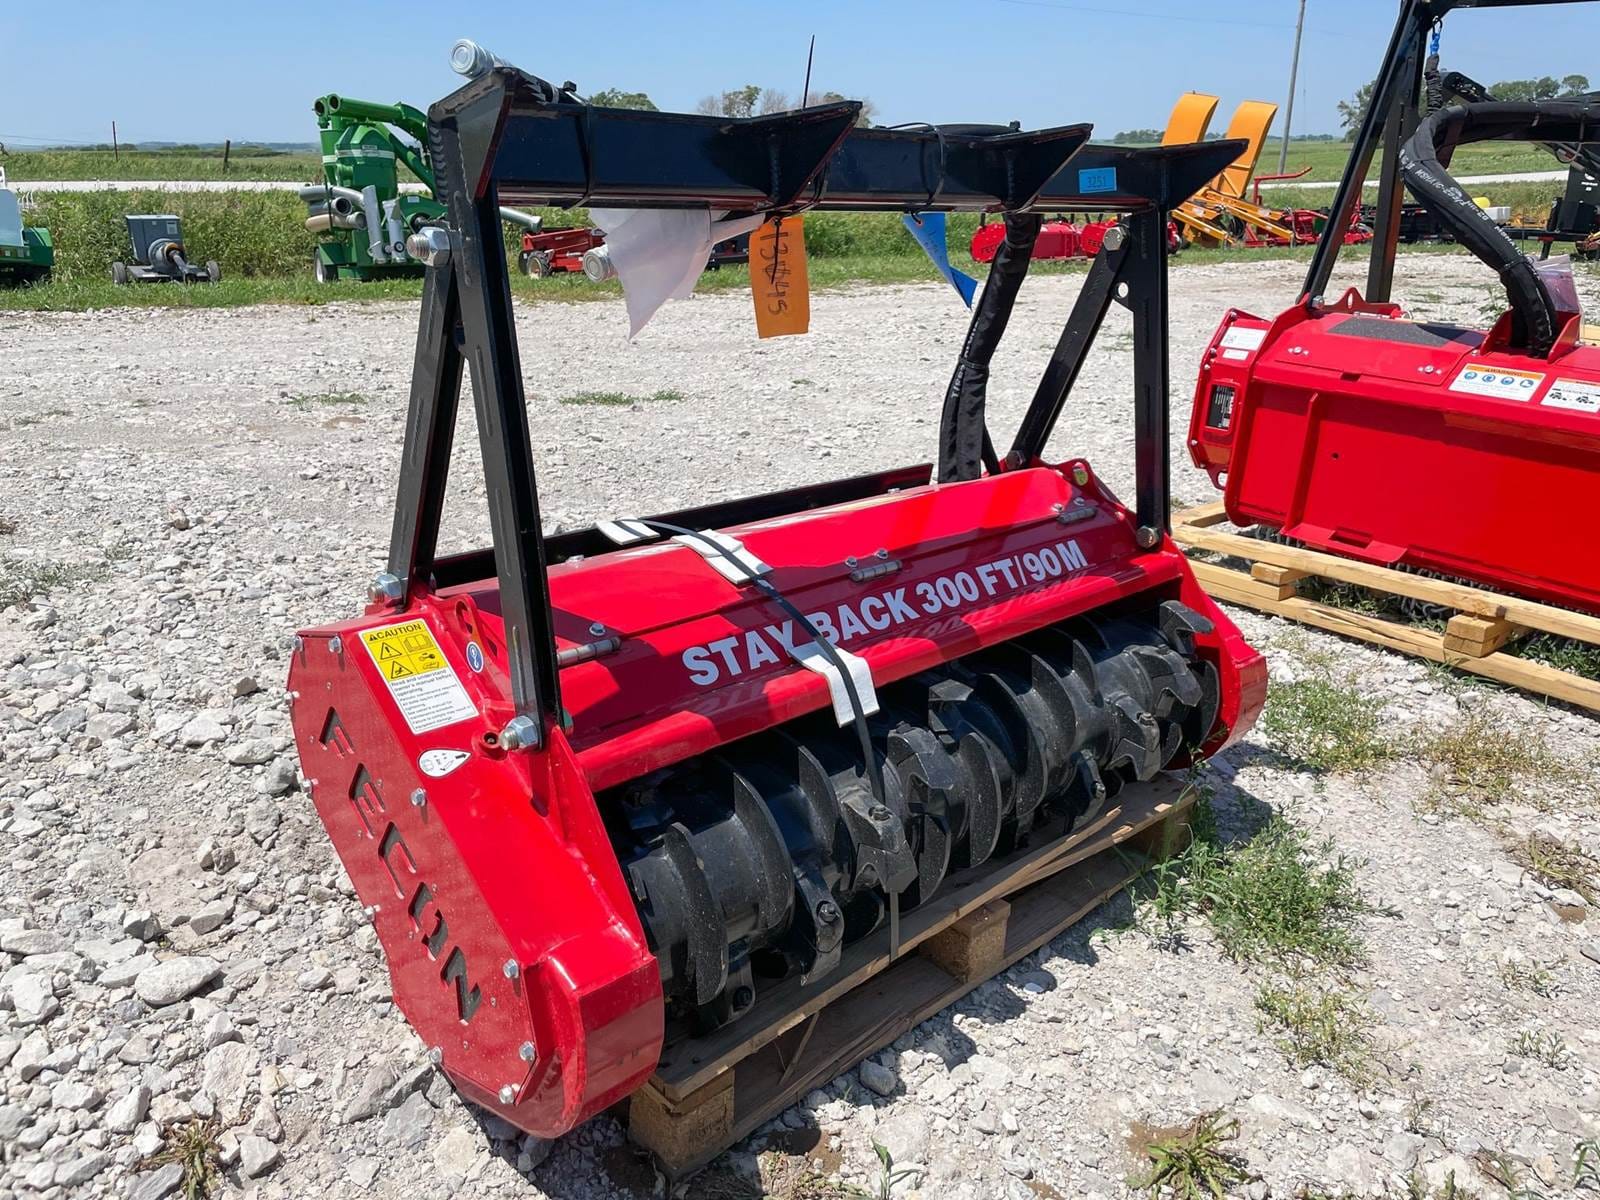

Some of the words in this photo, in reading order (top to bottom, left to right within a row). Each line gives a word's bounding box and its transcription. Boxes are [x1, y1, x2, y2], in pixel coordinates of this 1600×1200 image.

[376, 624, 422, 640] CAUTION
[682, 619, 801, 686] STAY
[806, 587, 922, 647] BACK
[916, 571, 981, 613] 300
[318, 706, 482, 1024] FECON
